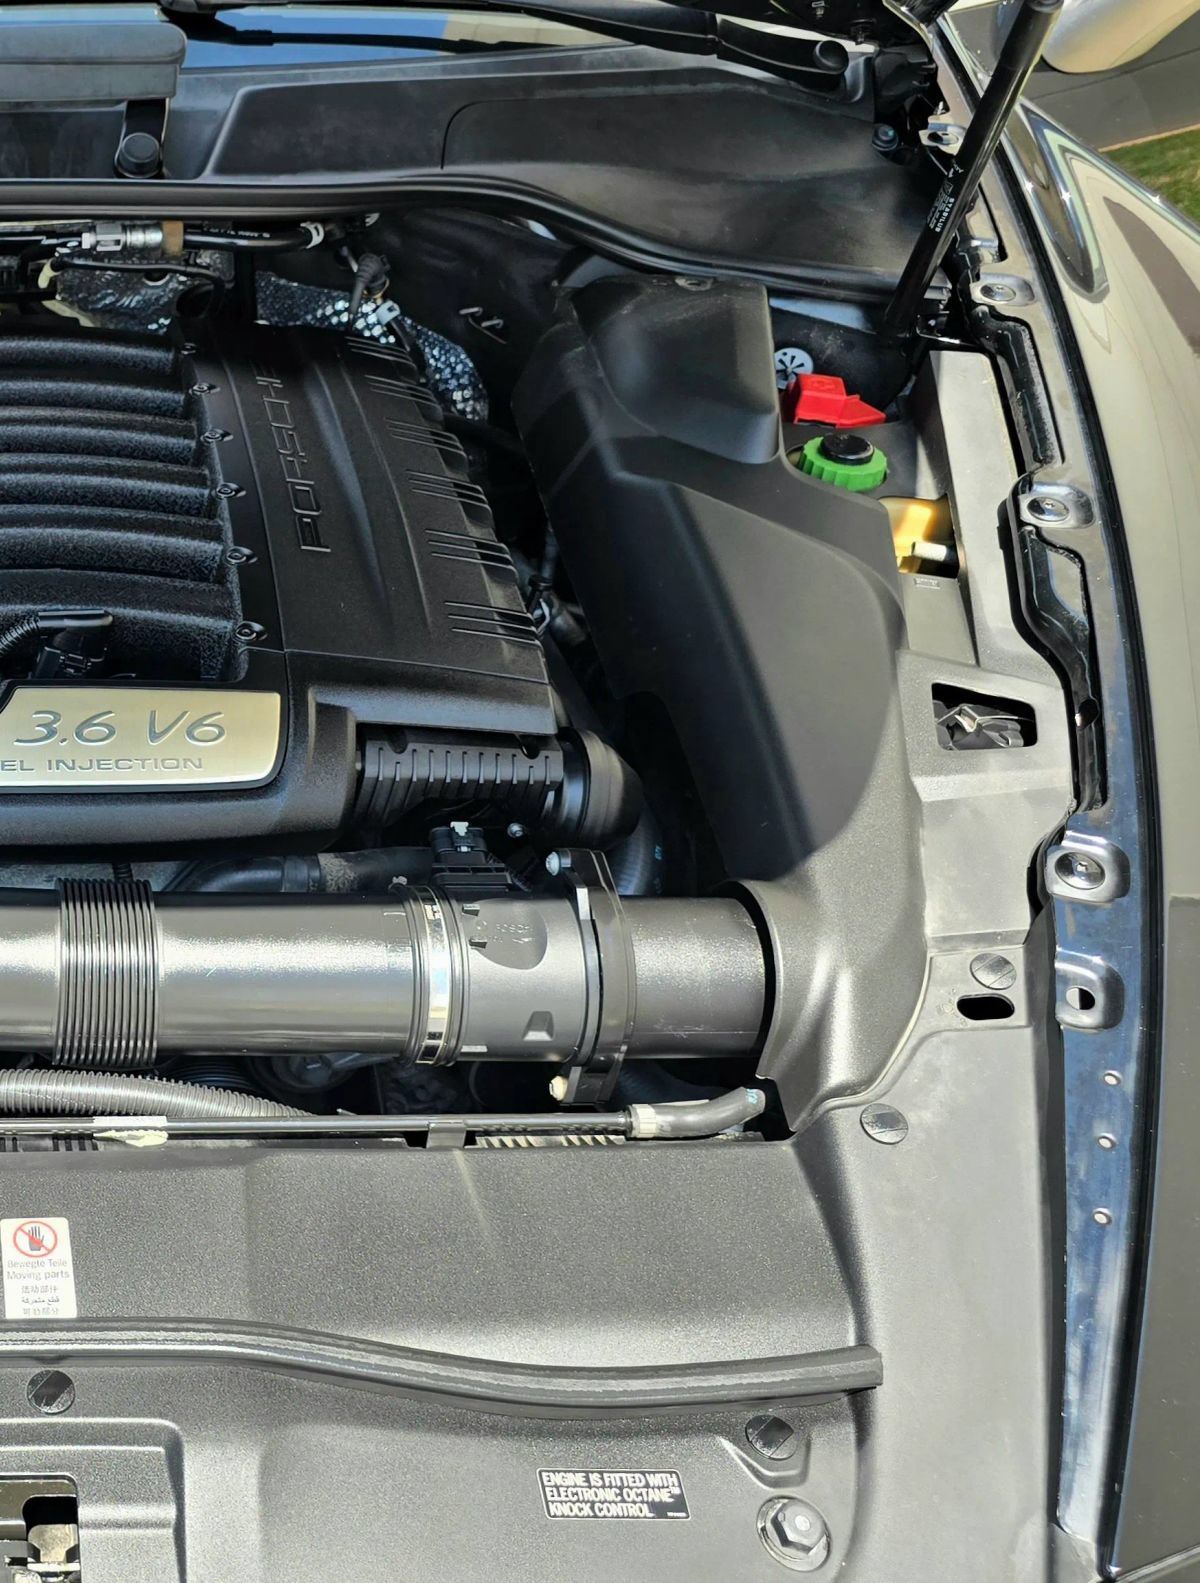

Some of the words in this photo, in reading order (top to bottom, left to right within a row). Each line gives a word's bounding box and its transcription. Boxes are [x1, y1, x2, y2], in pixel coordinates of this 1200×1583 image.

[250, 363, 331, 552] PORSCHE
[13, 710, 117, 747] 3.6
[146, 709, 227, 747] V6
[47, 757, 204, 772] INJECTION
[6, 1270, 42, 1281] Moving
[44, 1269, 70, 1280] parts
[541, 1472, 590, 1487] ENGINE
[590, 1473, 602, 1487] IS
[603, 1473, 646, 1487] FITTED
[646, 1473, 679, 1488] WITH
[545, 1487, 622, 1502] ELECTRONIC
[549, 1502, 594, 1517] KNOCK
[595, 1502, 655, 1518] CONTROL
